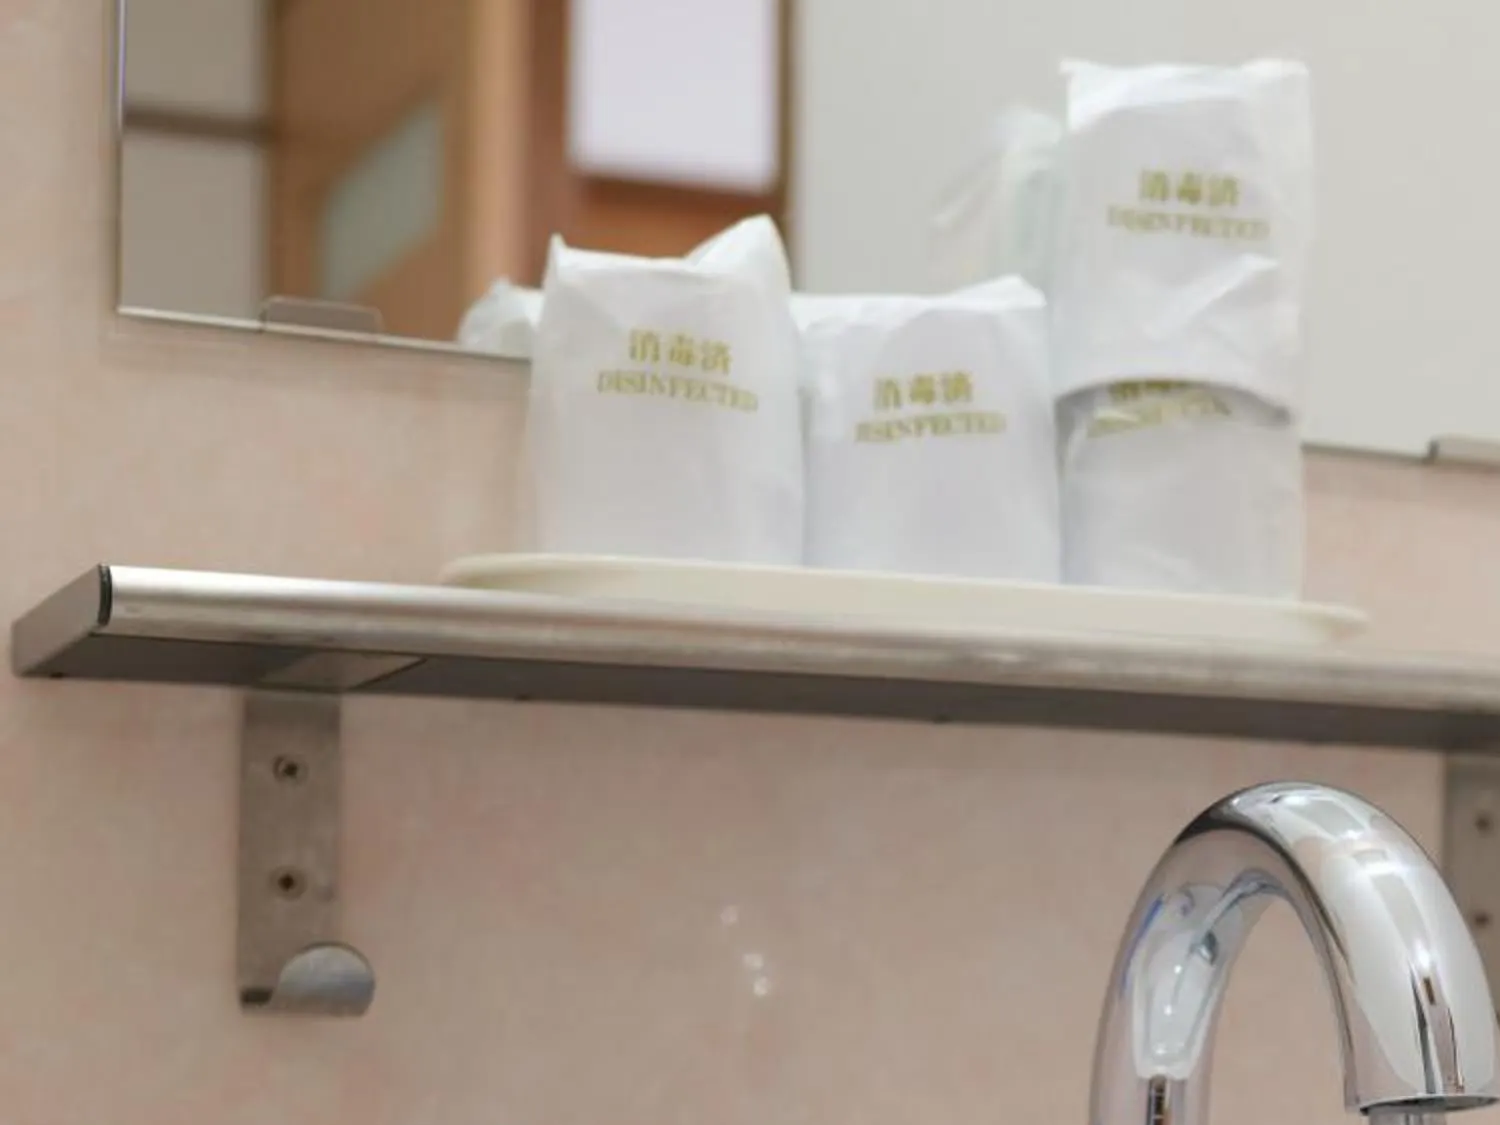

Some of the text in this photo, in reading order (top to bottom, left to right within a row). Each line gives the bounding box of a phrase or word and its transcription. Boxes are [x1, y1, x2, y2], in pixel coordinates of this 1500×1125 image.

[629, 328, 732, 375] 消毒済
[597, 370, 759, 412] DISINFECTED
